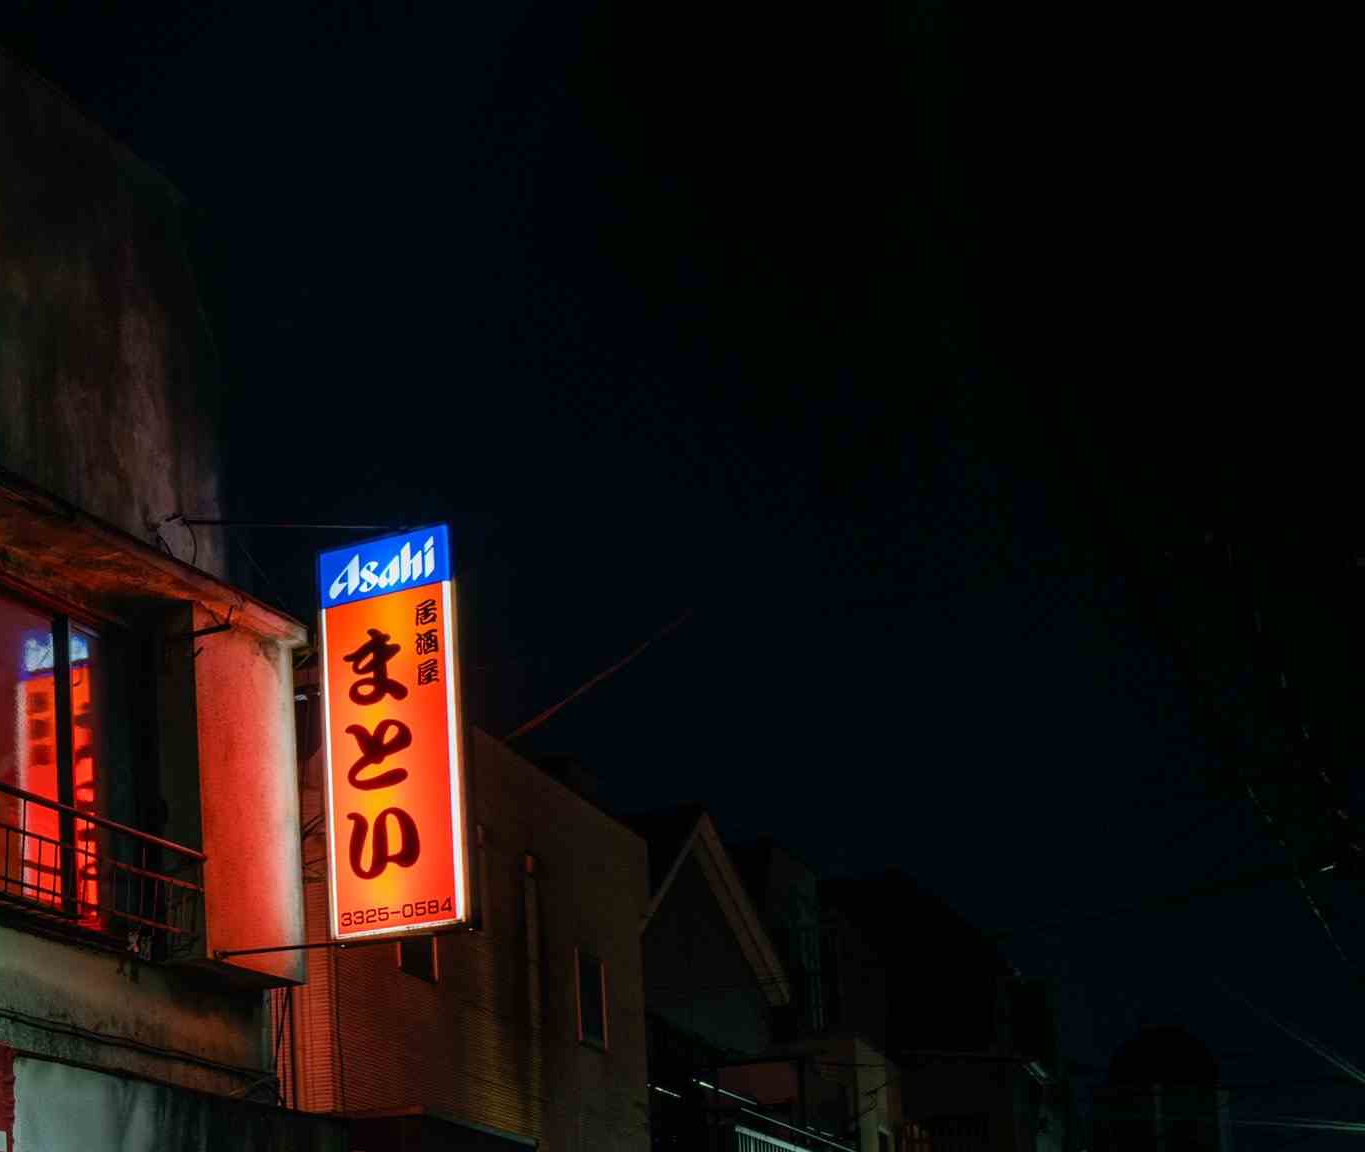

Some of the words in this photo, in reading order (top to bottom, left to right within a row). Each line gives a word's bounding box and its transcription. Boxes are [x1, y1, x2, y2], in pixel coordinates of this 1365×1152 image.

[328, 536, 436, 600] Asahi
[415, 599, 440, 686] 居酒屋
[343, 628, 420, 880] まとい
[340, 896, 453, 928] 3325-0584
